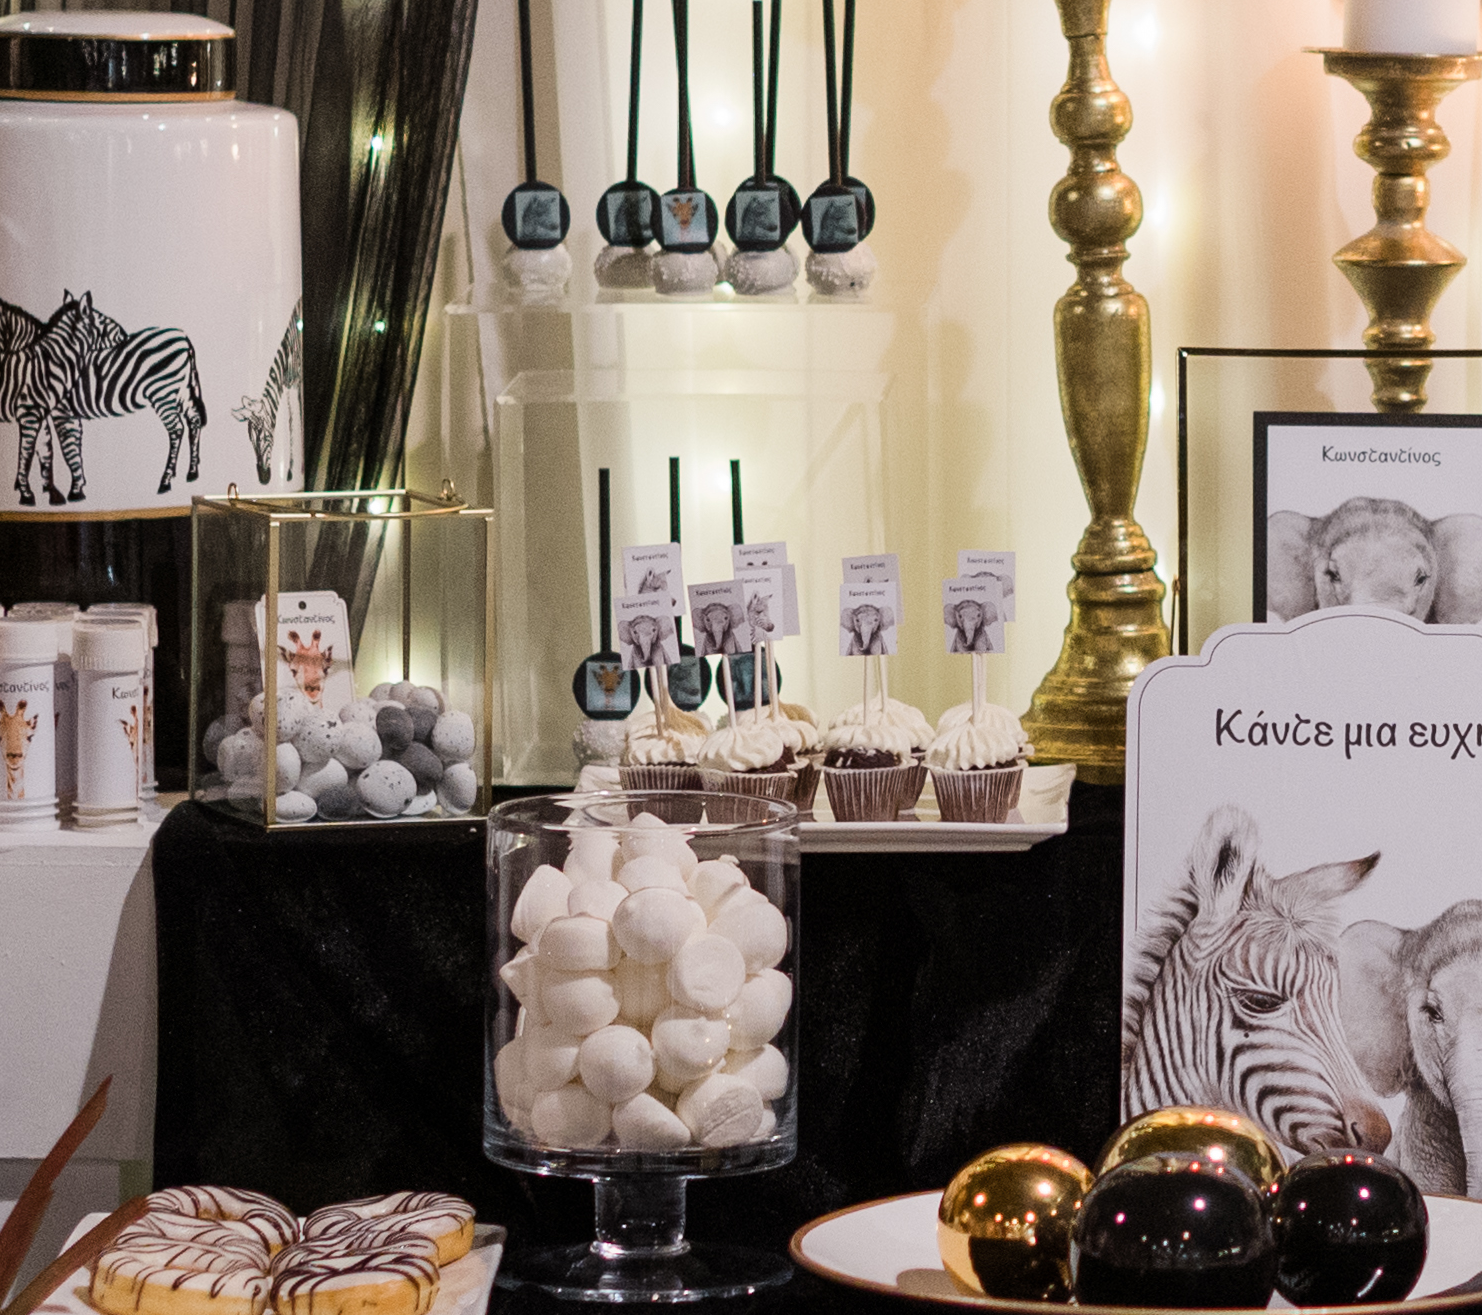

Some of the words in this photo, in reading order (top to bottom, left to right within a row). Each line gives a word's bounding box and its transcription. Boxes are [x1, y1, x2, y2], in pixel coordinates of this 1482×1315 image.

[1321, 444, 1442, 467] Κωνσταντίνος
[1215, 708, 1334, 747] Κάντε
[1344, 722, 1397, 760] μια
